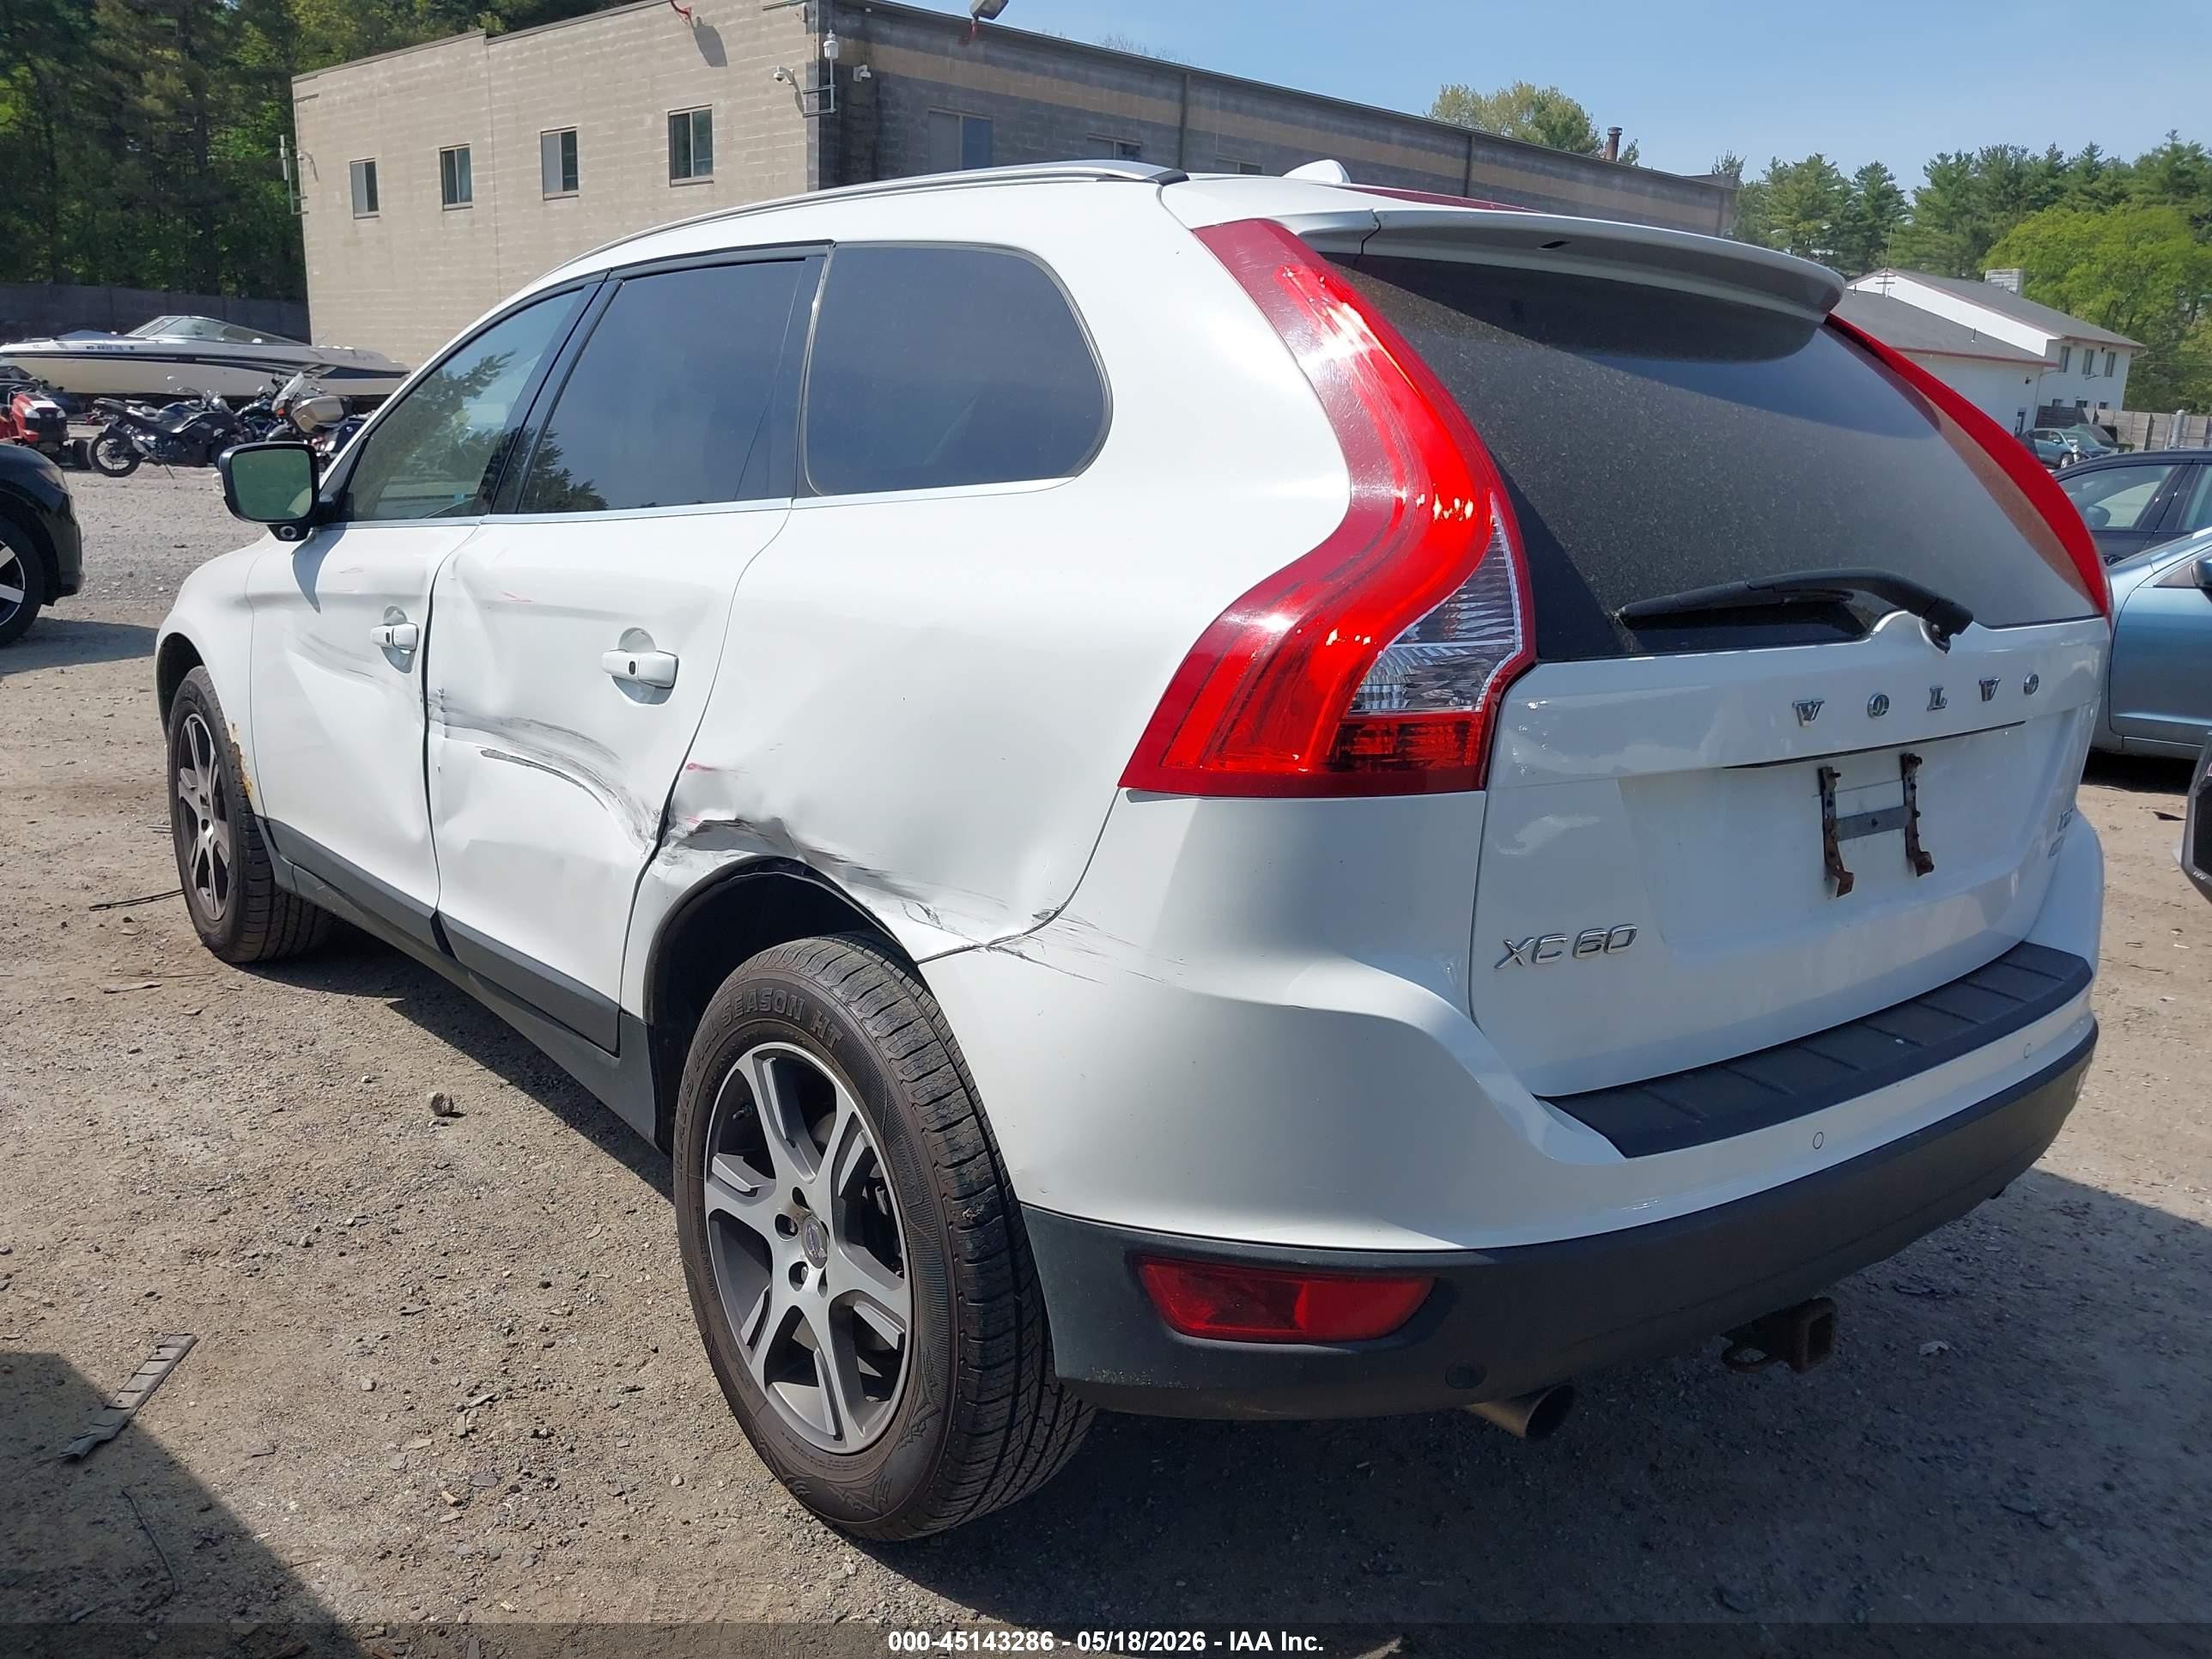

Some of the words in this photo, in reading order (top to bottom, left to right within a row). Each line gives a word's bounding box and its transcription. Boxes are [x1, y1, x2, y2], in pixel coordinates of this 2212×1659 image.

[1792, 672, 2040, 727] VOLVO
[721, 988, 806, 1028] SEASON
[810, 1007, 843, 1049] HT
